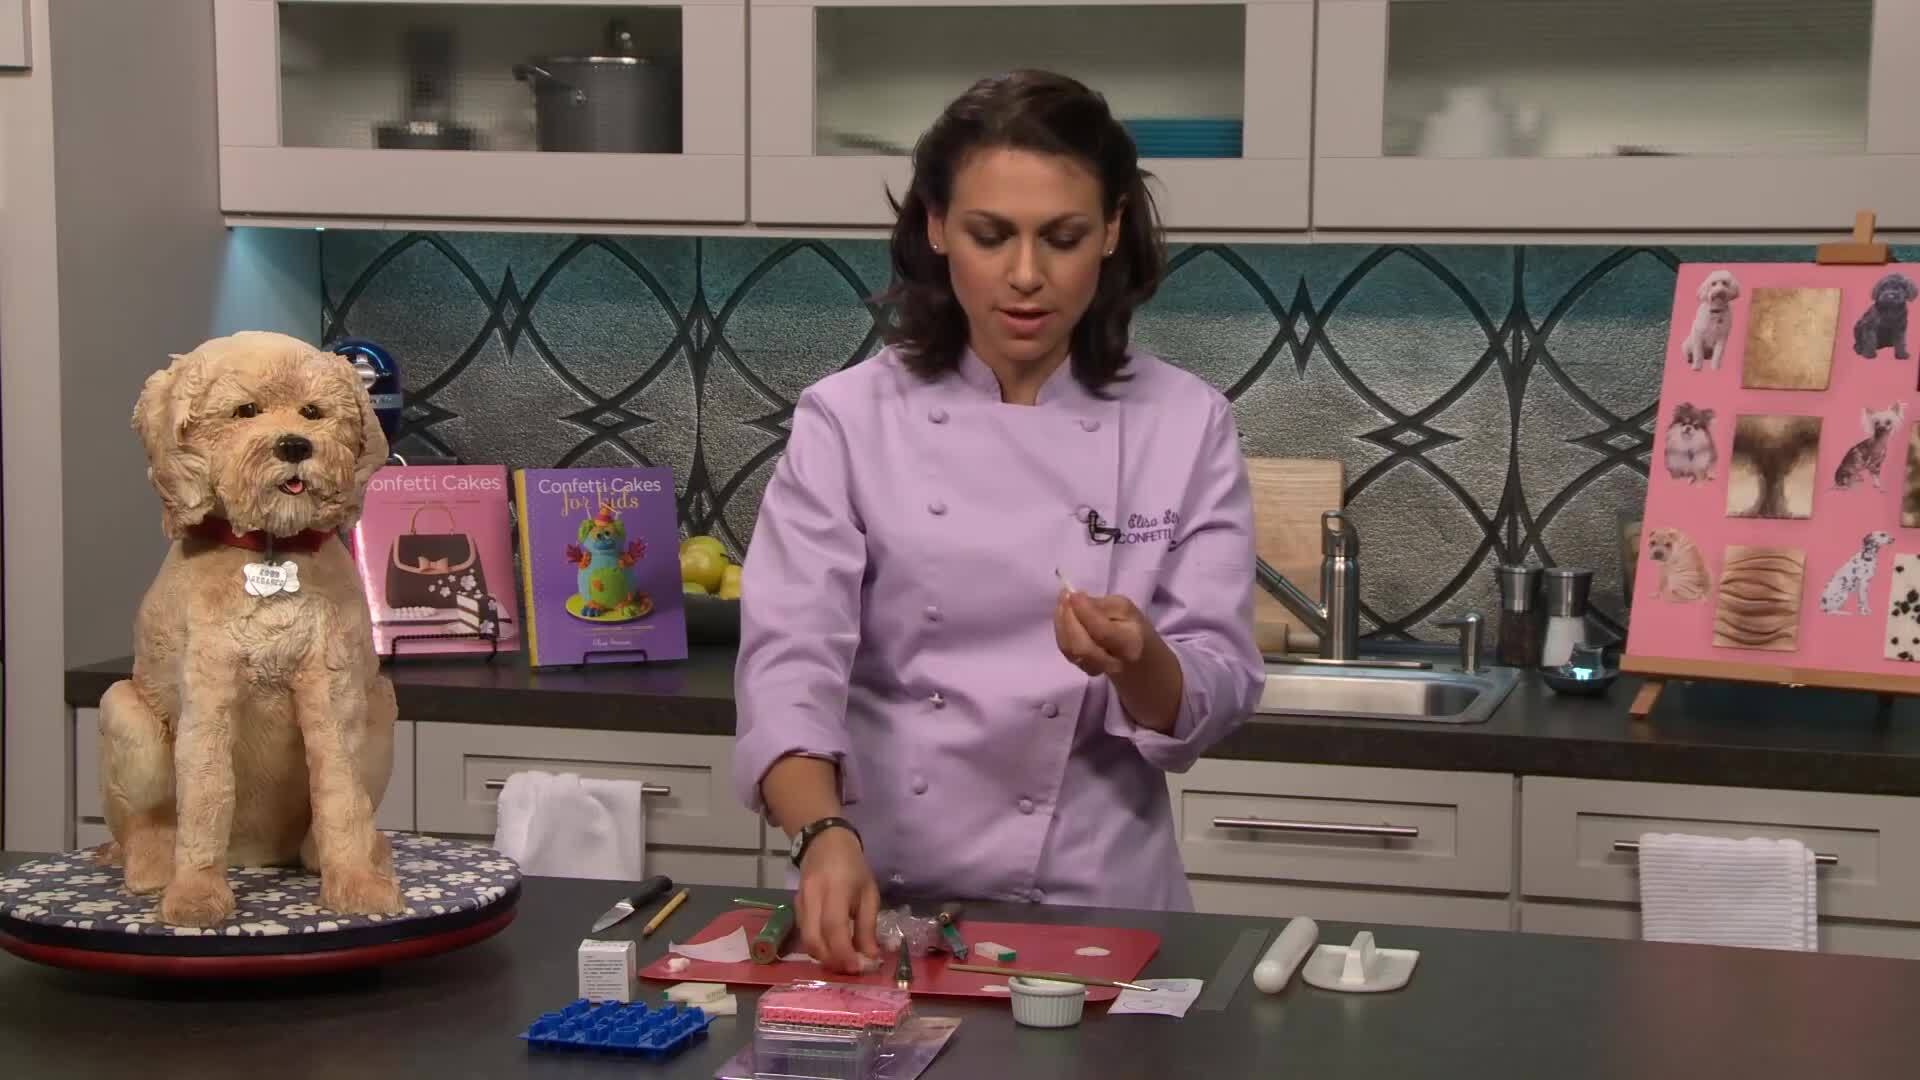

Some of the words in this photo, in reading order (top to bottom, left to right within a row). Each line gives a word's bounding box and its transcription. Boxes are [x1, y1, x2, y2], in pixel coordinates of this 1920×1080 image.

[367, 474, 437, 491] onfetti
[442, 474, 501, 491] Cakes
[538, 477, 608, 494] Confetti
[611, 476, 662, 492] Cakes
[561, 488, 592, 516] for
[595, 483, 640, 509] kids
